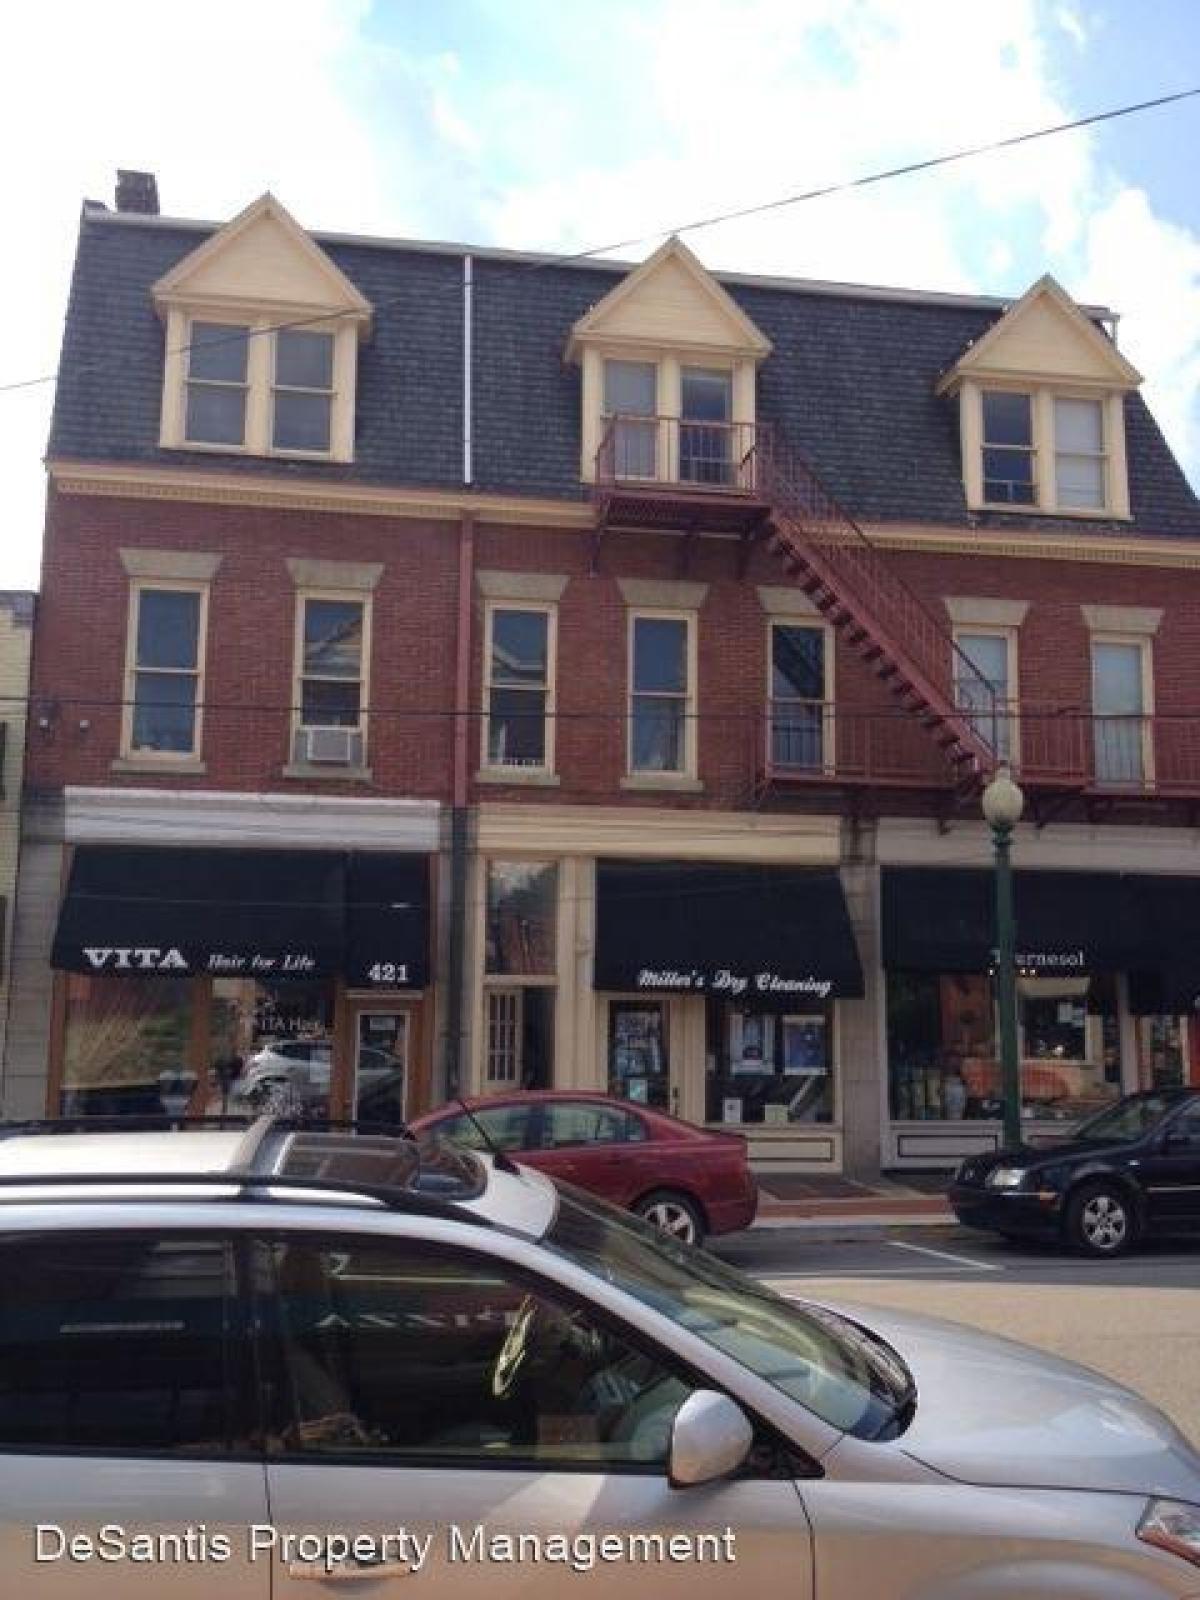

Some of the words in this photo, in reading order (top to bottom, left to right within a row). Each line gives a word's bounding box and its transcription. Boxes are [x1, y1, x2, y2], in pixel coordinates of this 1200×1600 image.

[84, 947, 188, 968] VITA
[990, 949, 1084, 966] Turnesol
[368, 964, 408, 981] 421
[712, 969, 749, 995] Dry
[755, 971, 831, 998] Cleaning
